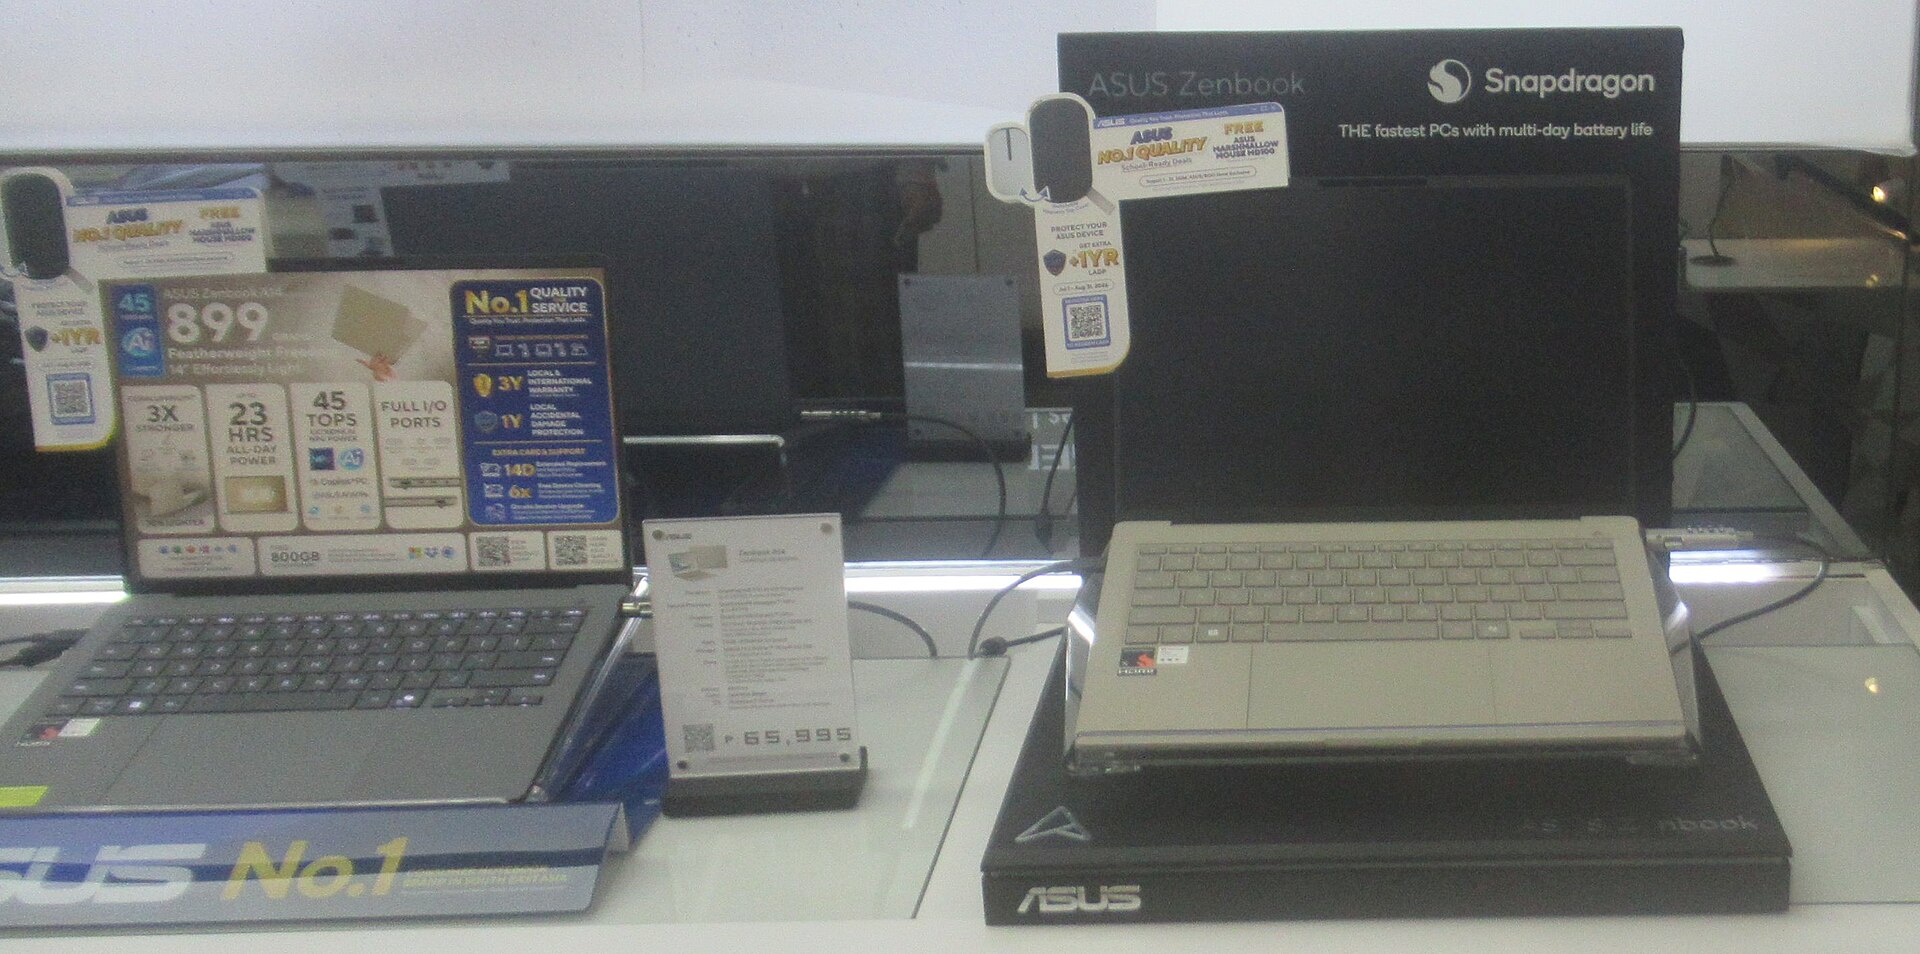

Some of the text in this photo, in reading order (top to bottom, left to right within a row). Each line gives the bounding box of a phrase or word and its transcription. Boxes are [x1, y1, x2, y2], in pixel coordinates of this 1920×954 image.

[1088, 71, 1305, 97] ASUS Zenbook
[1484, 67, 1655, 98] Snapdragon
[1130, 126, 1173, 145] ASUS
[1224, 121, 1264, 135] FREE
[1339, 121, 1654, 140] THE fastest PCs with multi-day battery life
[1213, 140, 1279, 153] MARSHMALLOW
[1233, 136, 1255, 144] ASUS
[1097, 136, 1208, 165] NO.1 QUALITY
[1051, 221, 1107, 233] PROTECT YOUR
[1056, 229, 1104, 240] ASUS DEVICE
[1069, 247, 1119, 268] +1YR
[119, 294, 149, 312] 45
[465, 286, 588, 315] No.1 QUALITY
[531, 302, 589, 314] SERVICE
[167, 301, 269, 344] 899
[498, 376, 523, 391] 3Y
[313, 391, 347, 410] 45
[381, 400, 447, 412] FULL I/O
[146, 404, 180, 422] 3X
[229, 402, 268, 426] 23
[306, 413, 358, 428] TOPS
[390, 417, 442, 429] PORTS
[228, 427, 274, 442] HRS
[230, 456, 276, 466] POWER
[503, 463, 536, 477] 14D
[271, 551, 321, 563] 800GB
[744, 727, 852, 746] 65,995
[1617, 814, 1759, 833] Znbook
[223, 837, 410, 900] No.1
[1017, 885, 1141, 913] ASUS
